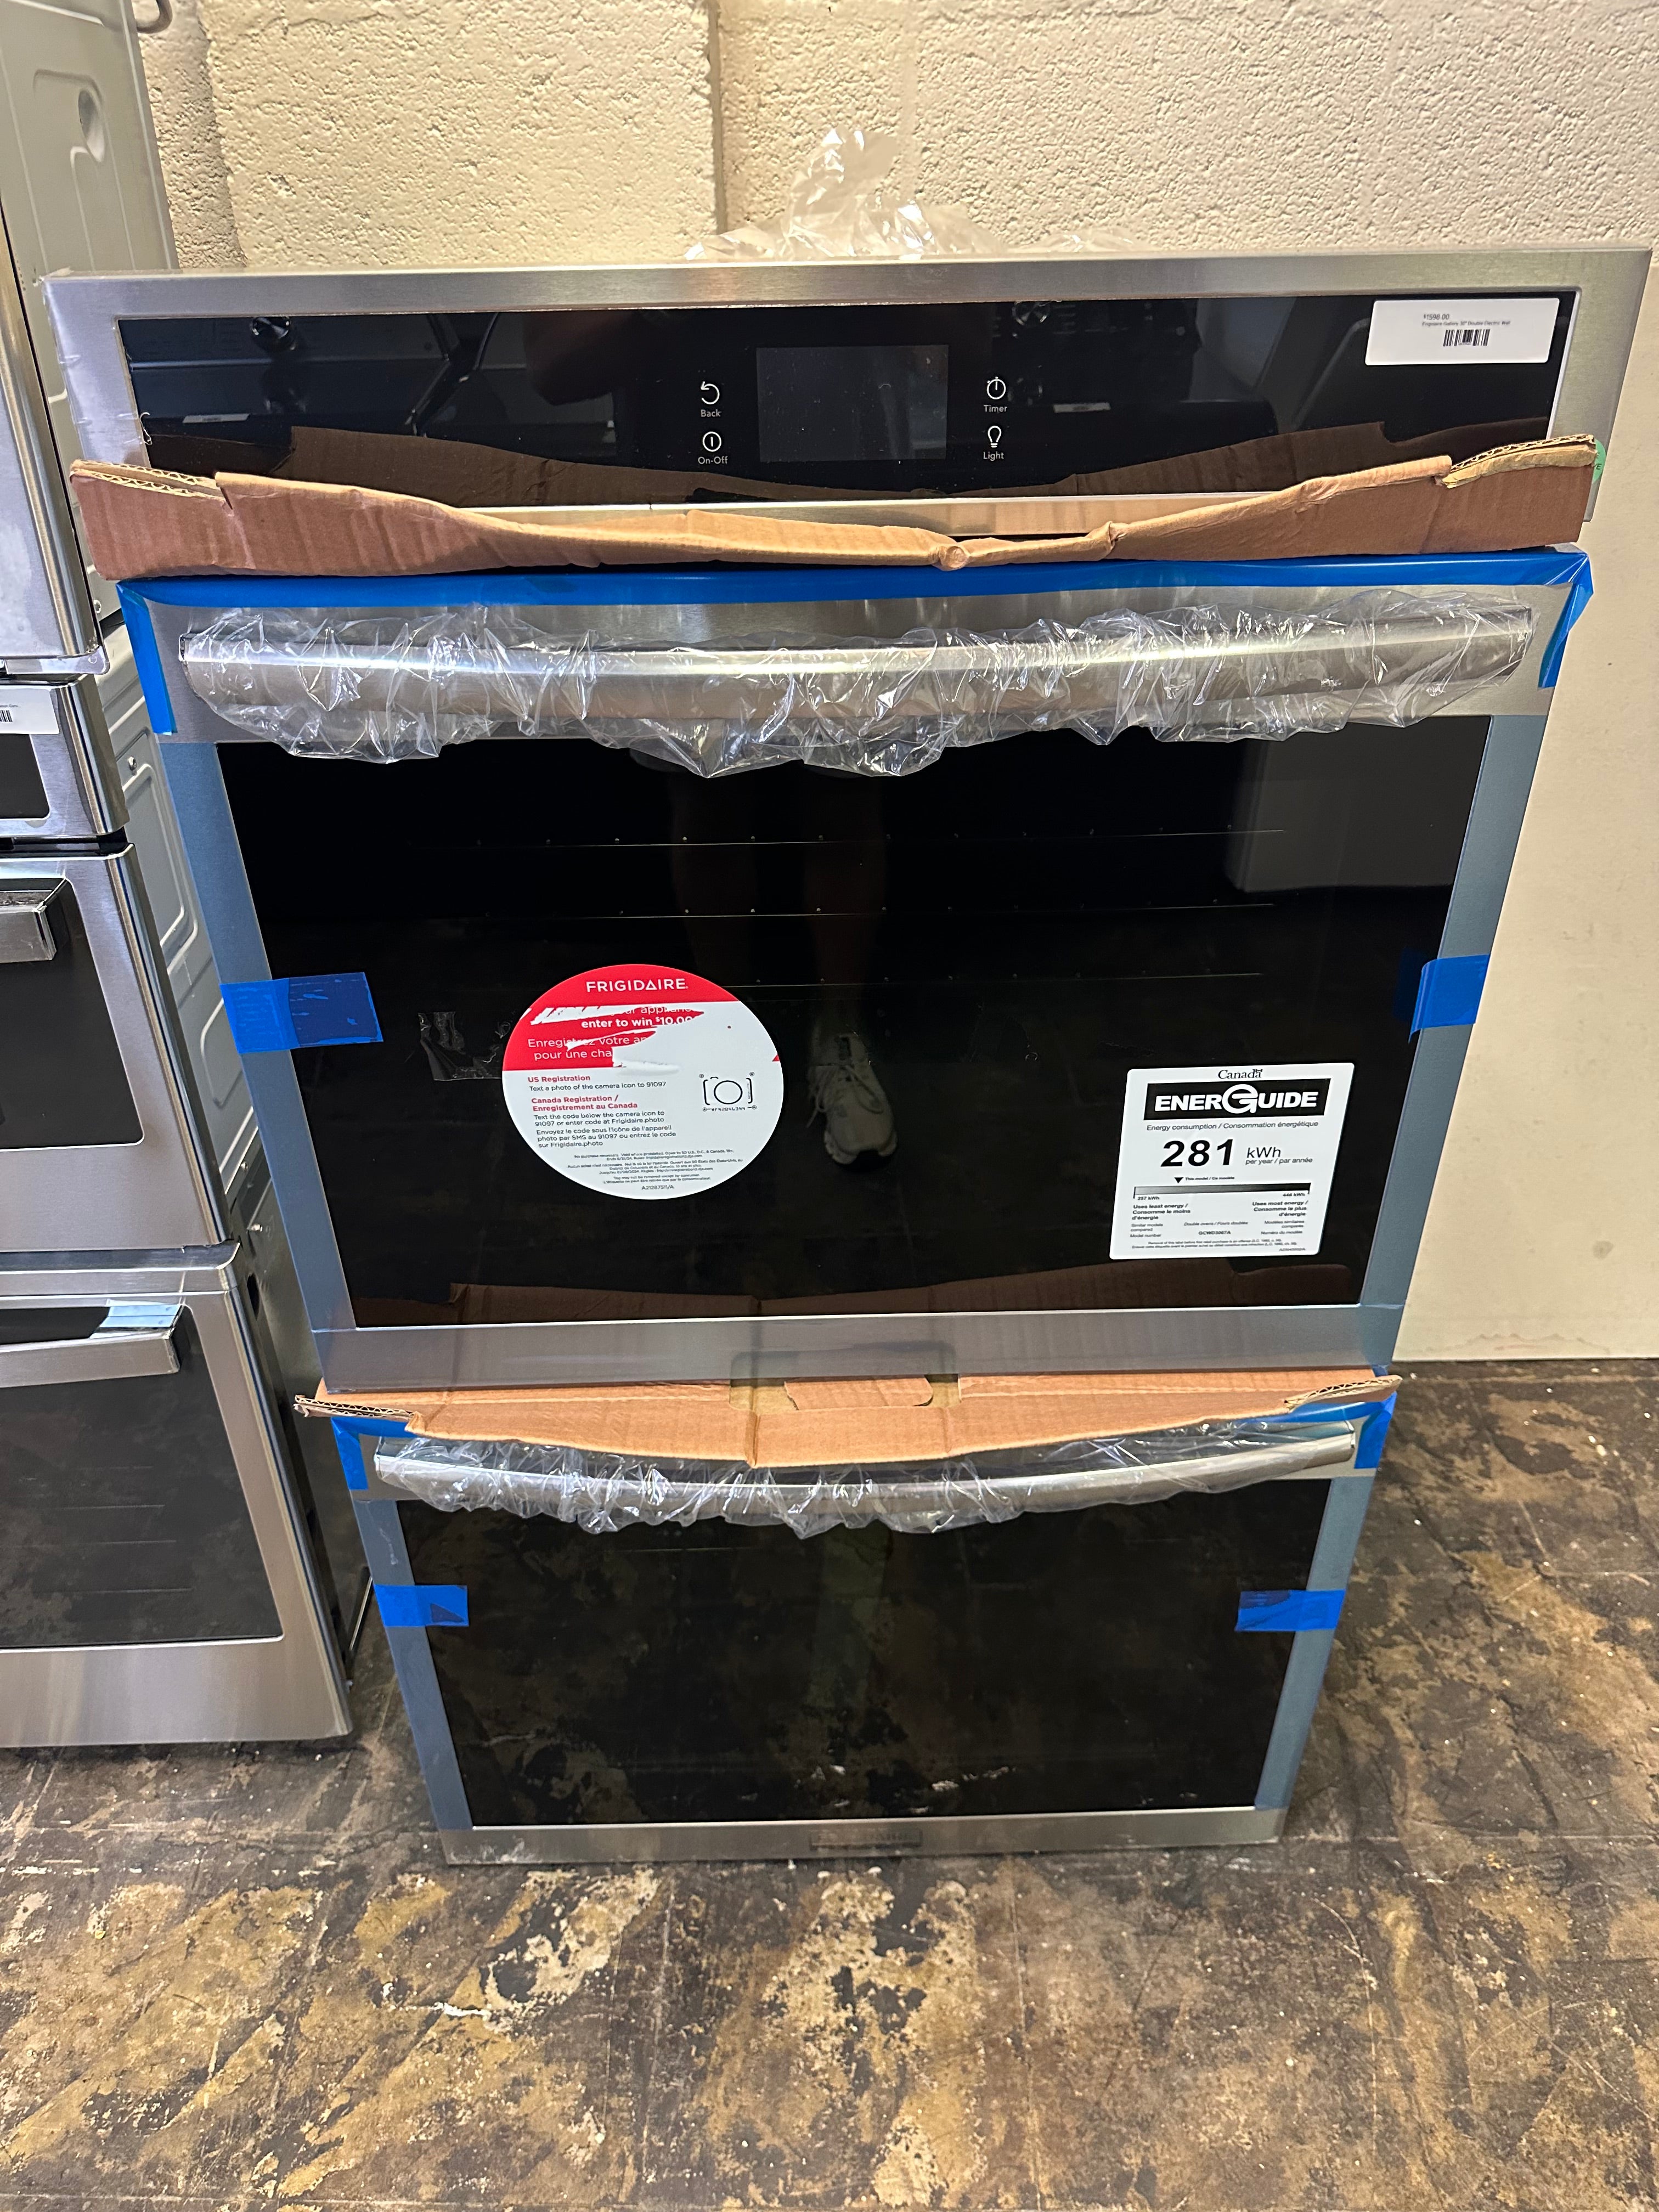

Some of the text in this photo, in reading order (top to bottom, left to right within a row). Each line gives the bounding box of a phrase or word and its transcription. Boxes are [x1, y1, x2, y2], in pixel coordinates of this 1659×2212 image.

[701, 409, 721, 417] Back
[984, 404, 1008, 413] Timer
[698, 456, 728, 465] On-Off
[983, 452, 1005, 461] Light
[586, 978, 689, 992] FRIGIDAIRE
[582, 1019, 613, 1029] enter
[616, 1018, 628, 1026] to
[631, 1017, 652, 1026] win
[599, 1036, 630, 1045] votre
[534, 1052, 562, 1061] pour
[1218, 1069, 1262, 1080] Canada
[541, 1075, 591, 1084] Registration
[564, 1095, 612, 1104] Registration
[1154, 1084, 1318, 1114] ENERGUIDE
[533, 1104, 594, 1113] Enregistrement
[612, 1117, 664, 1125] Frigidaire.photo
[550, 1141, 603, 1149] Frigidaire.photo
[1160, 1139, 1233, 1167] 281
[1247, 1147, 1281, 1159] kWh
